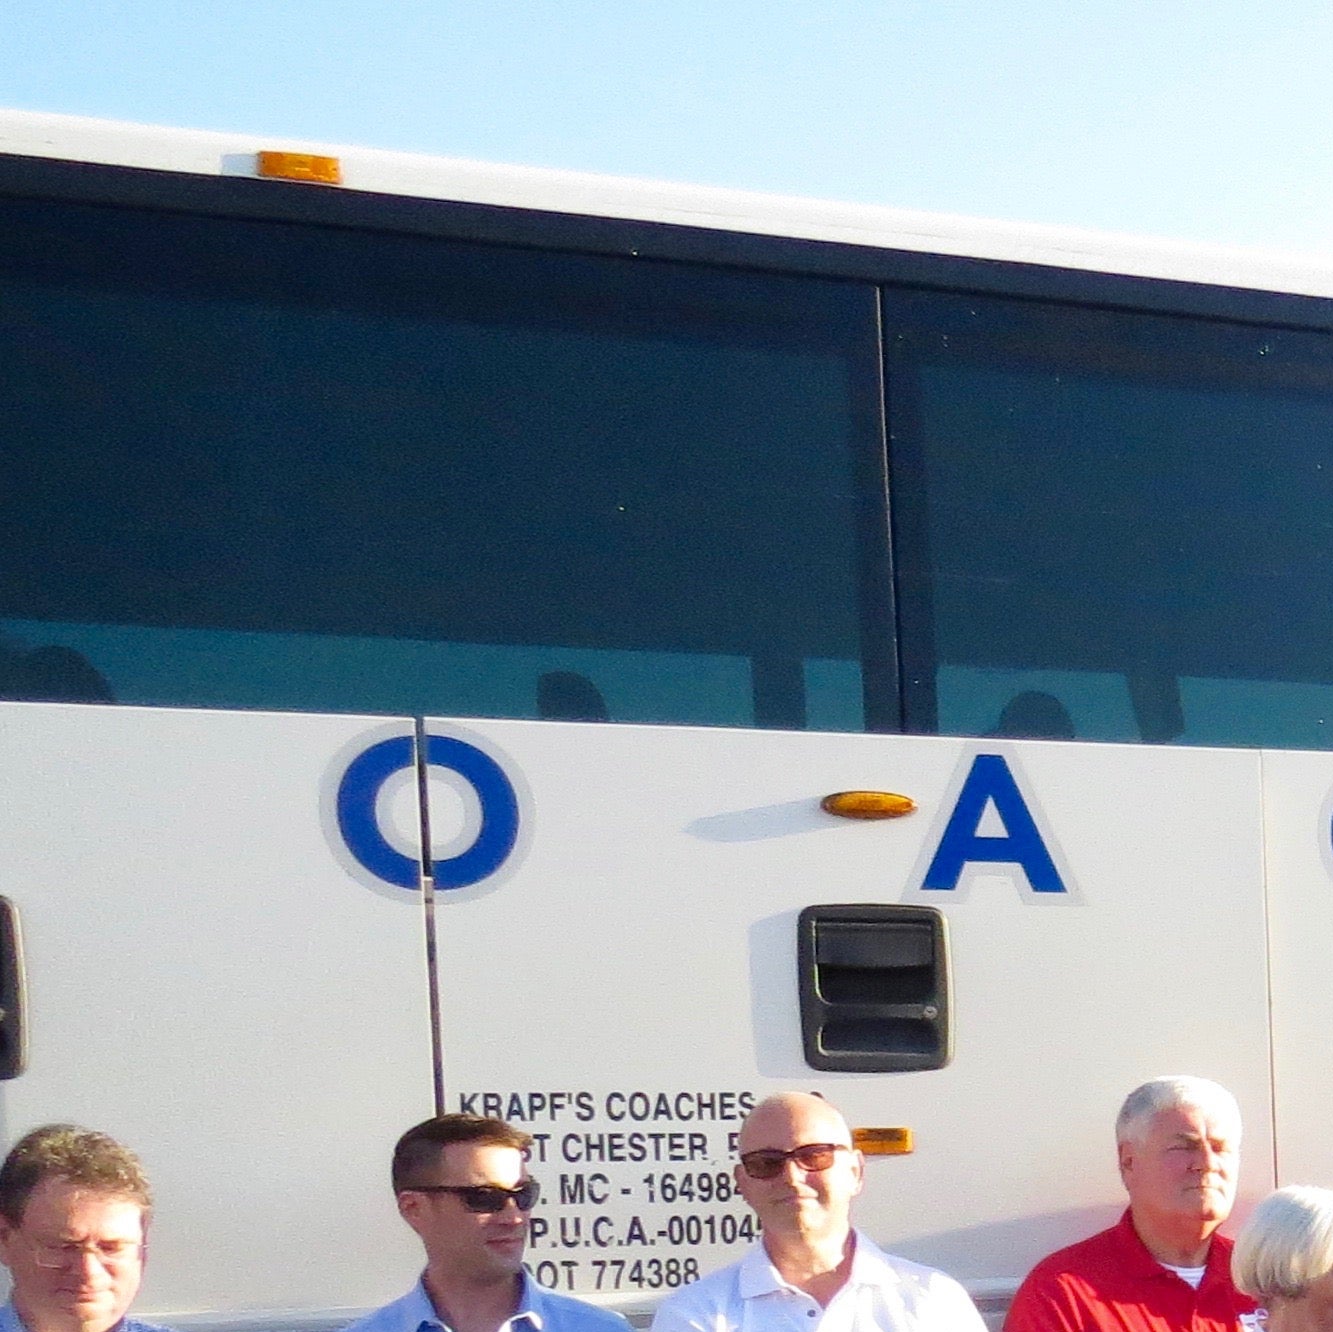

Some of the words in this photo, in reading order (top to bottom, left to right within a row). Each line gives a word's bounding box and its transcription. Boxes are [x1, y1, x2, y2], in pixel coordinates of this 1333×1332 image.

[459, 1092, 595, 1122] KRAPF'S
[560, 1173, 610, 1204] MC
[592, 1257, 700, 1289] 774388
